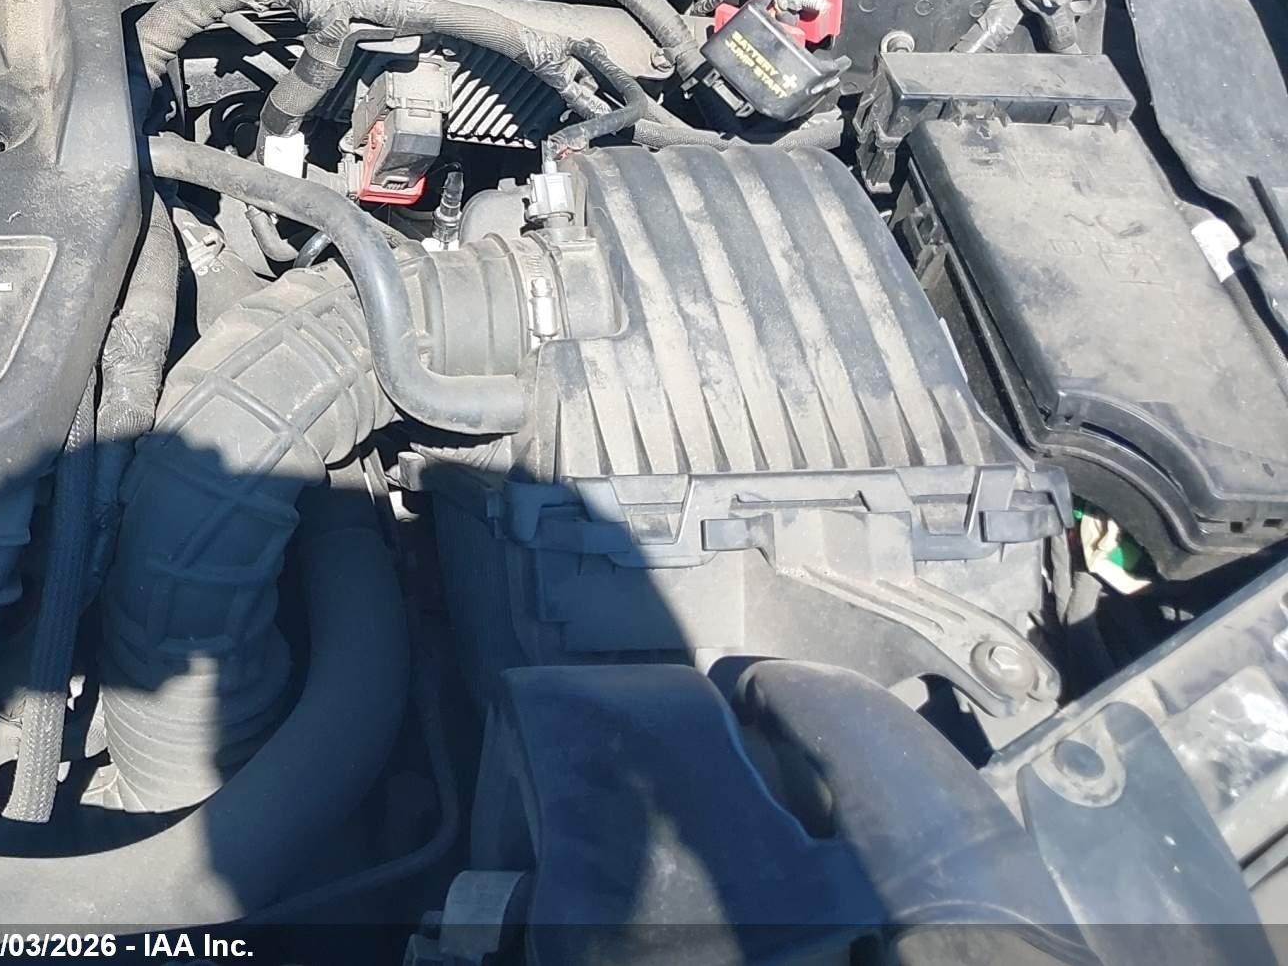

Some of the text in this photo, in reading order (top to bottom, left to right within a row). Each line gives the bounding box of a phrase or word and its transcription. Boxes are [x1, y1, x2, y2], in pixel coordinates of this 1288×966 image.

[724, 39, 788, 99] JUMP START
[732, 30, 779, 75] BATTERY
